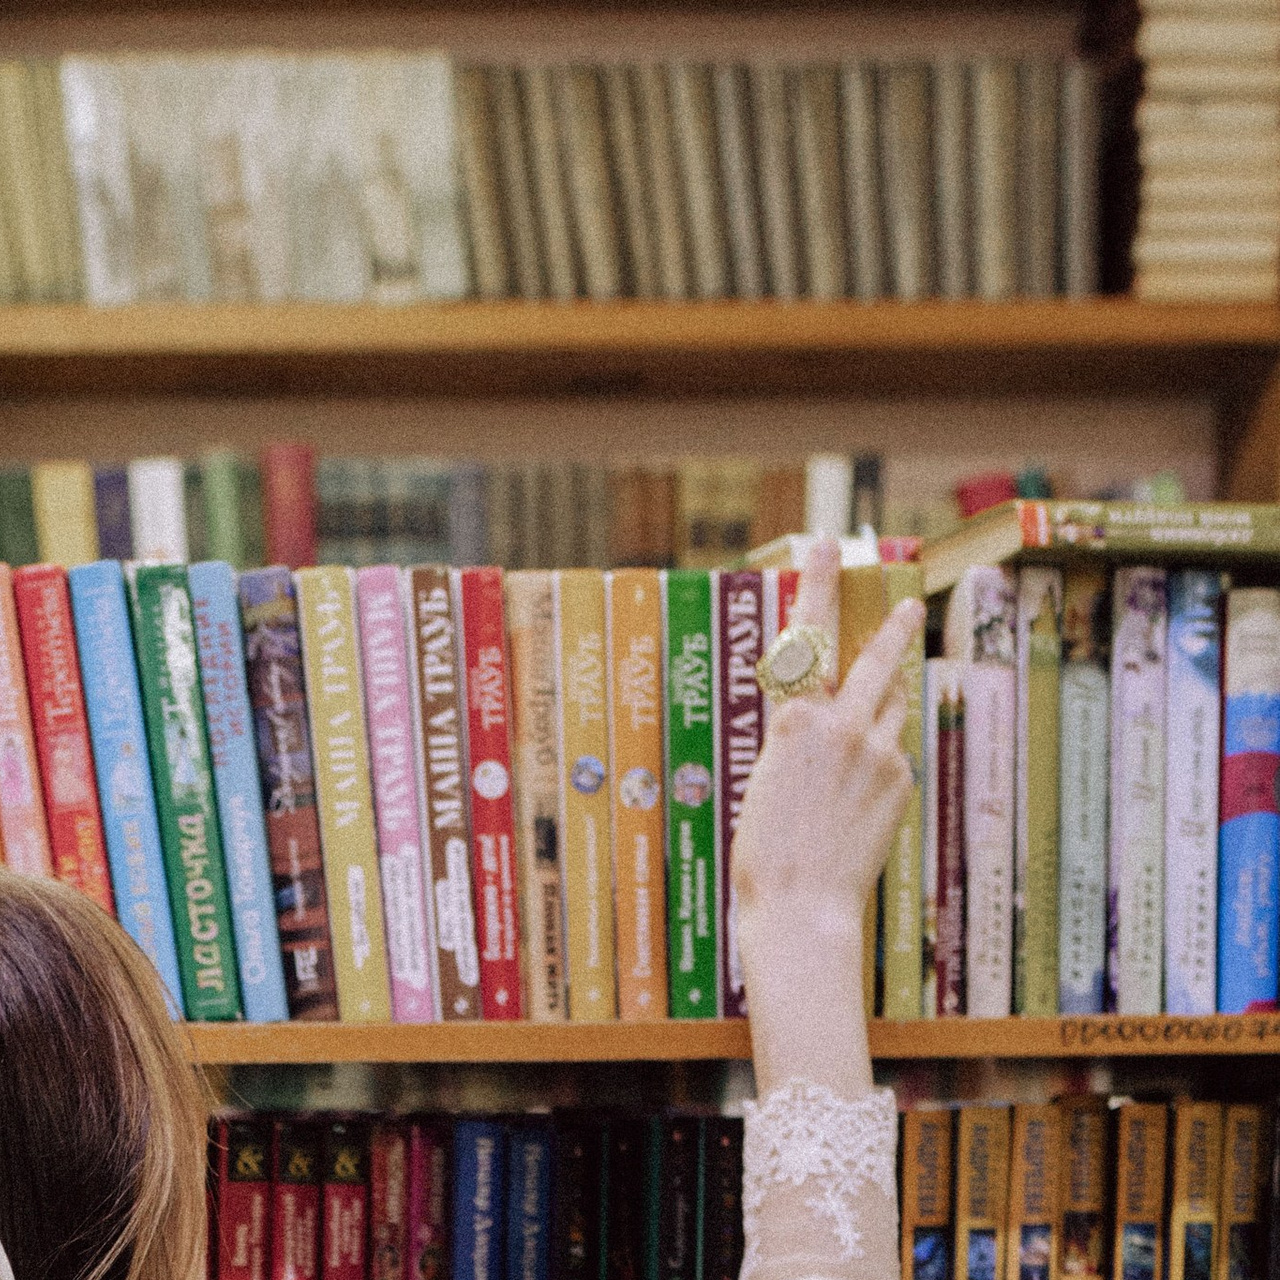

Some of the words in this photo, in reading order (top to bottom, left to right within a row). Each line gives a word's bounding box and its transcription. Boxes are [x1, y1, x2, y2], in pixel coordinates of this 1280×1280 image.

[193, 596, 231, 768] ПОСЛЕДНИЕ
[215, 621, 245, 737] ИСТОРИИ
[314, 588, 346, 700] ТРАУБ
[364, 592, 402, 713] МАША
[418, 587, 453, 701] ТРАУБ
[477, 646, 507, 731] ТРАУБ
[573, 631, 600, 727] ТРАУБ
[628, 634, 658, 730] ТРАУБ
[681, 632, 710, 728] ТРАУБ
[727, 590, 758, 703] ТРАУБ
[328, 710, 362, 829] МАША
[375, 719, 412, 831] ТРАУБ
[426, 709, 465, 828] МАША
[233, 908, 267, 985] Ольга
